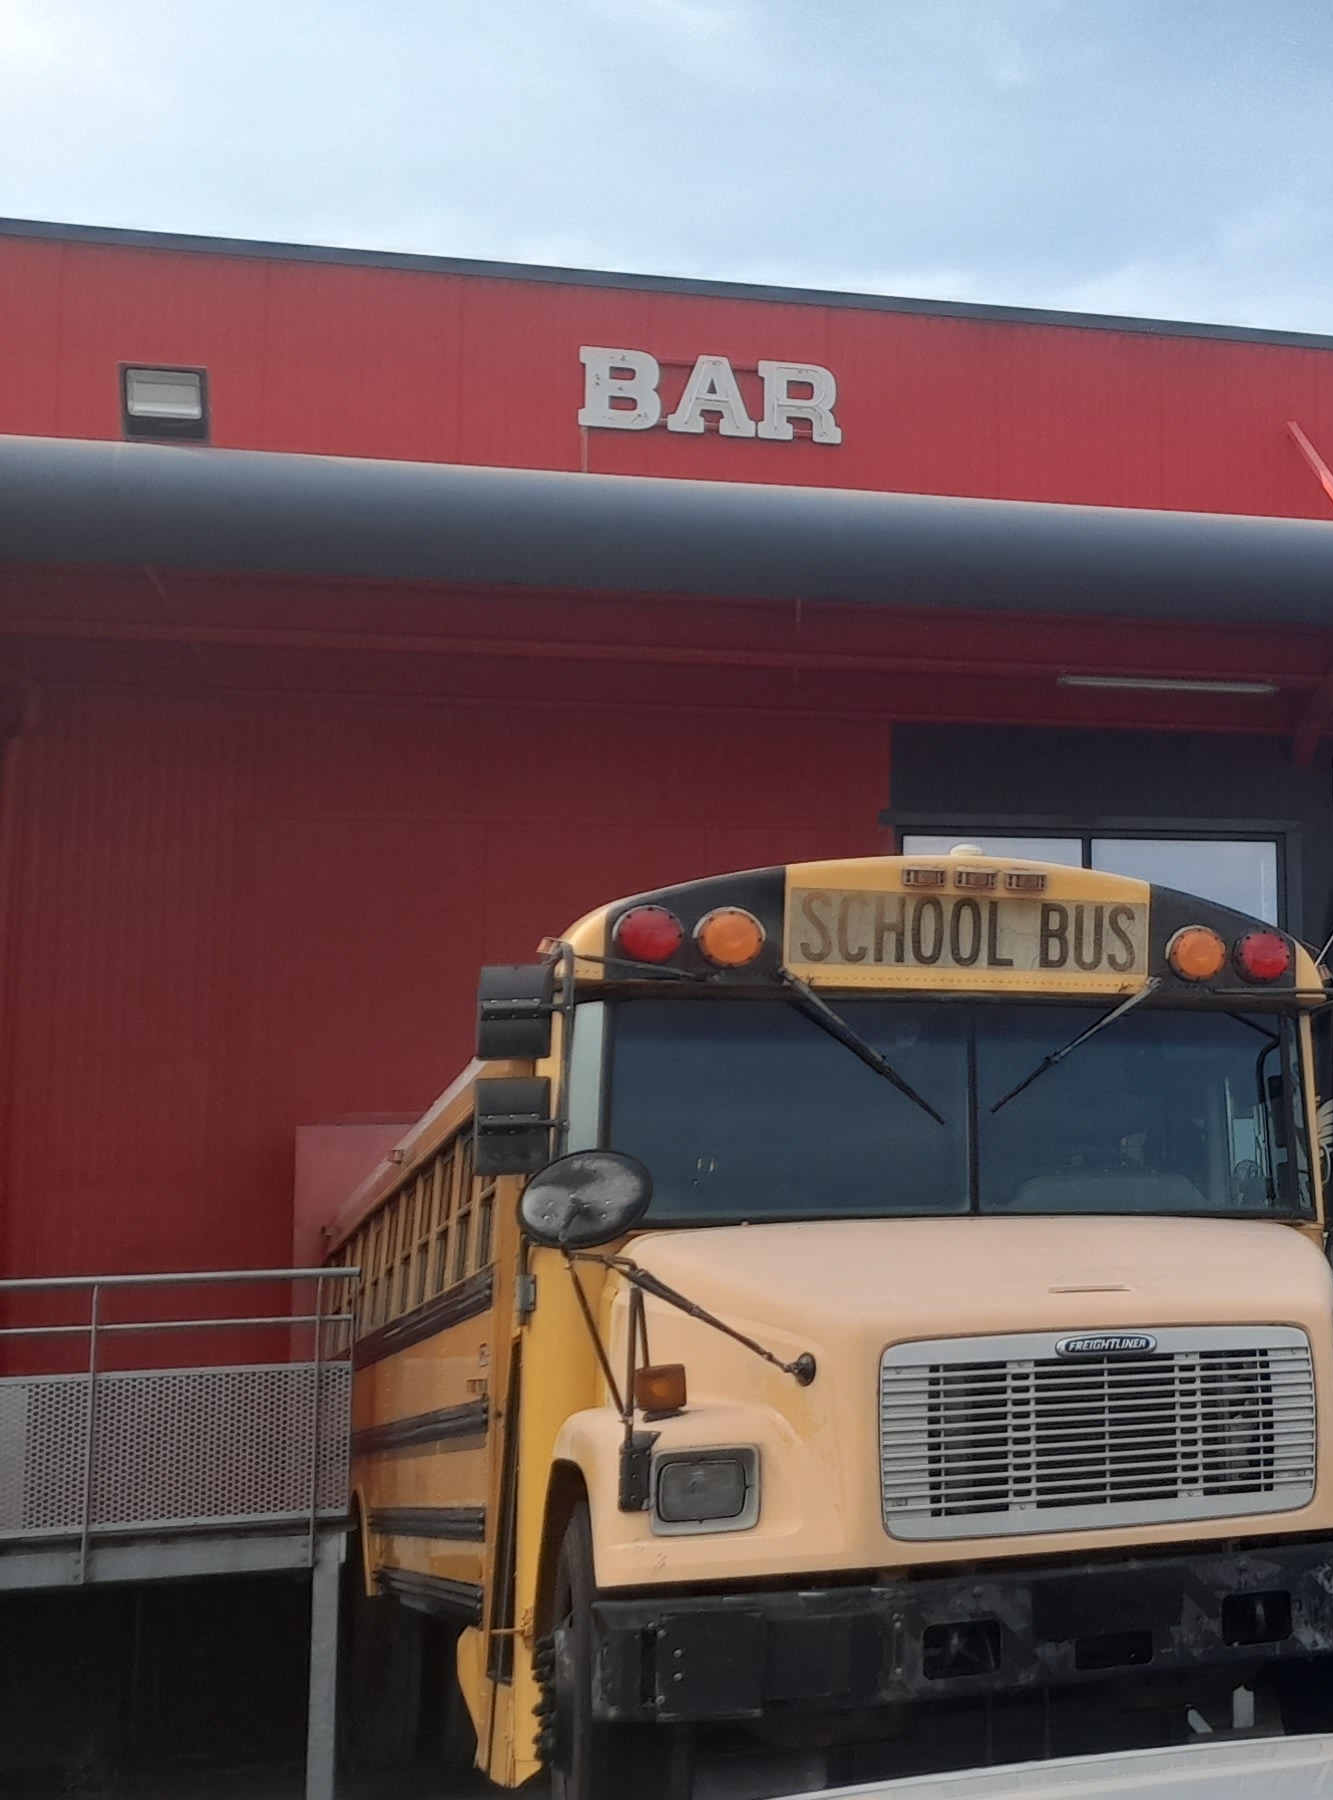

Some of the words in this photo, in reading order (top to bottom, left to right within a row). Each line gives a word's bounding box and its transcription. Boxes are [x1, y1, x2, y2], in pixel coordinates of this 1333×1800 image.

[577, 345, 842, 445] BAR
[801, 892, 1013, 967] SCHOOL
[1039, 902, 1135, 971] BUS
[1068, 1338, 1147, 1351] FREIGHTLINER
